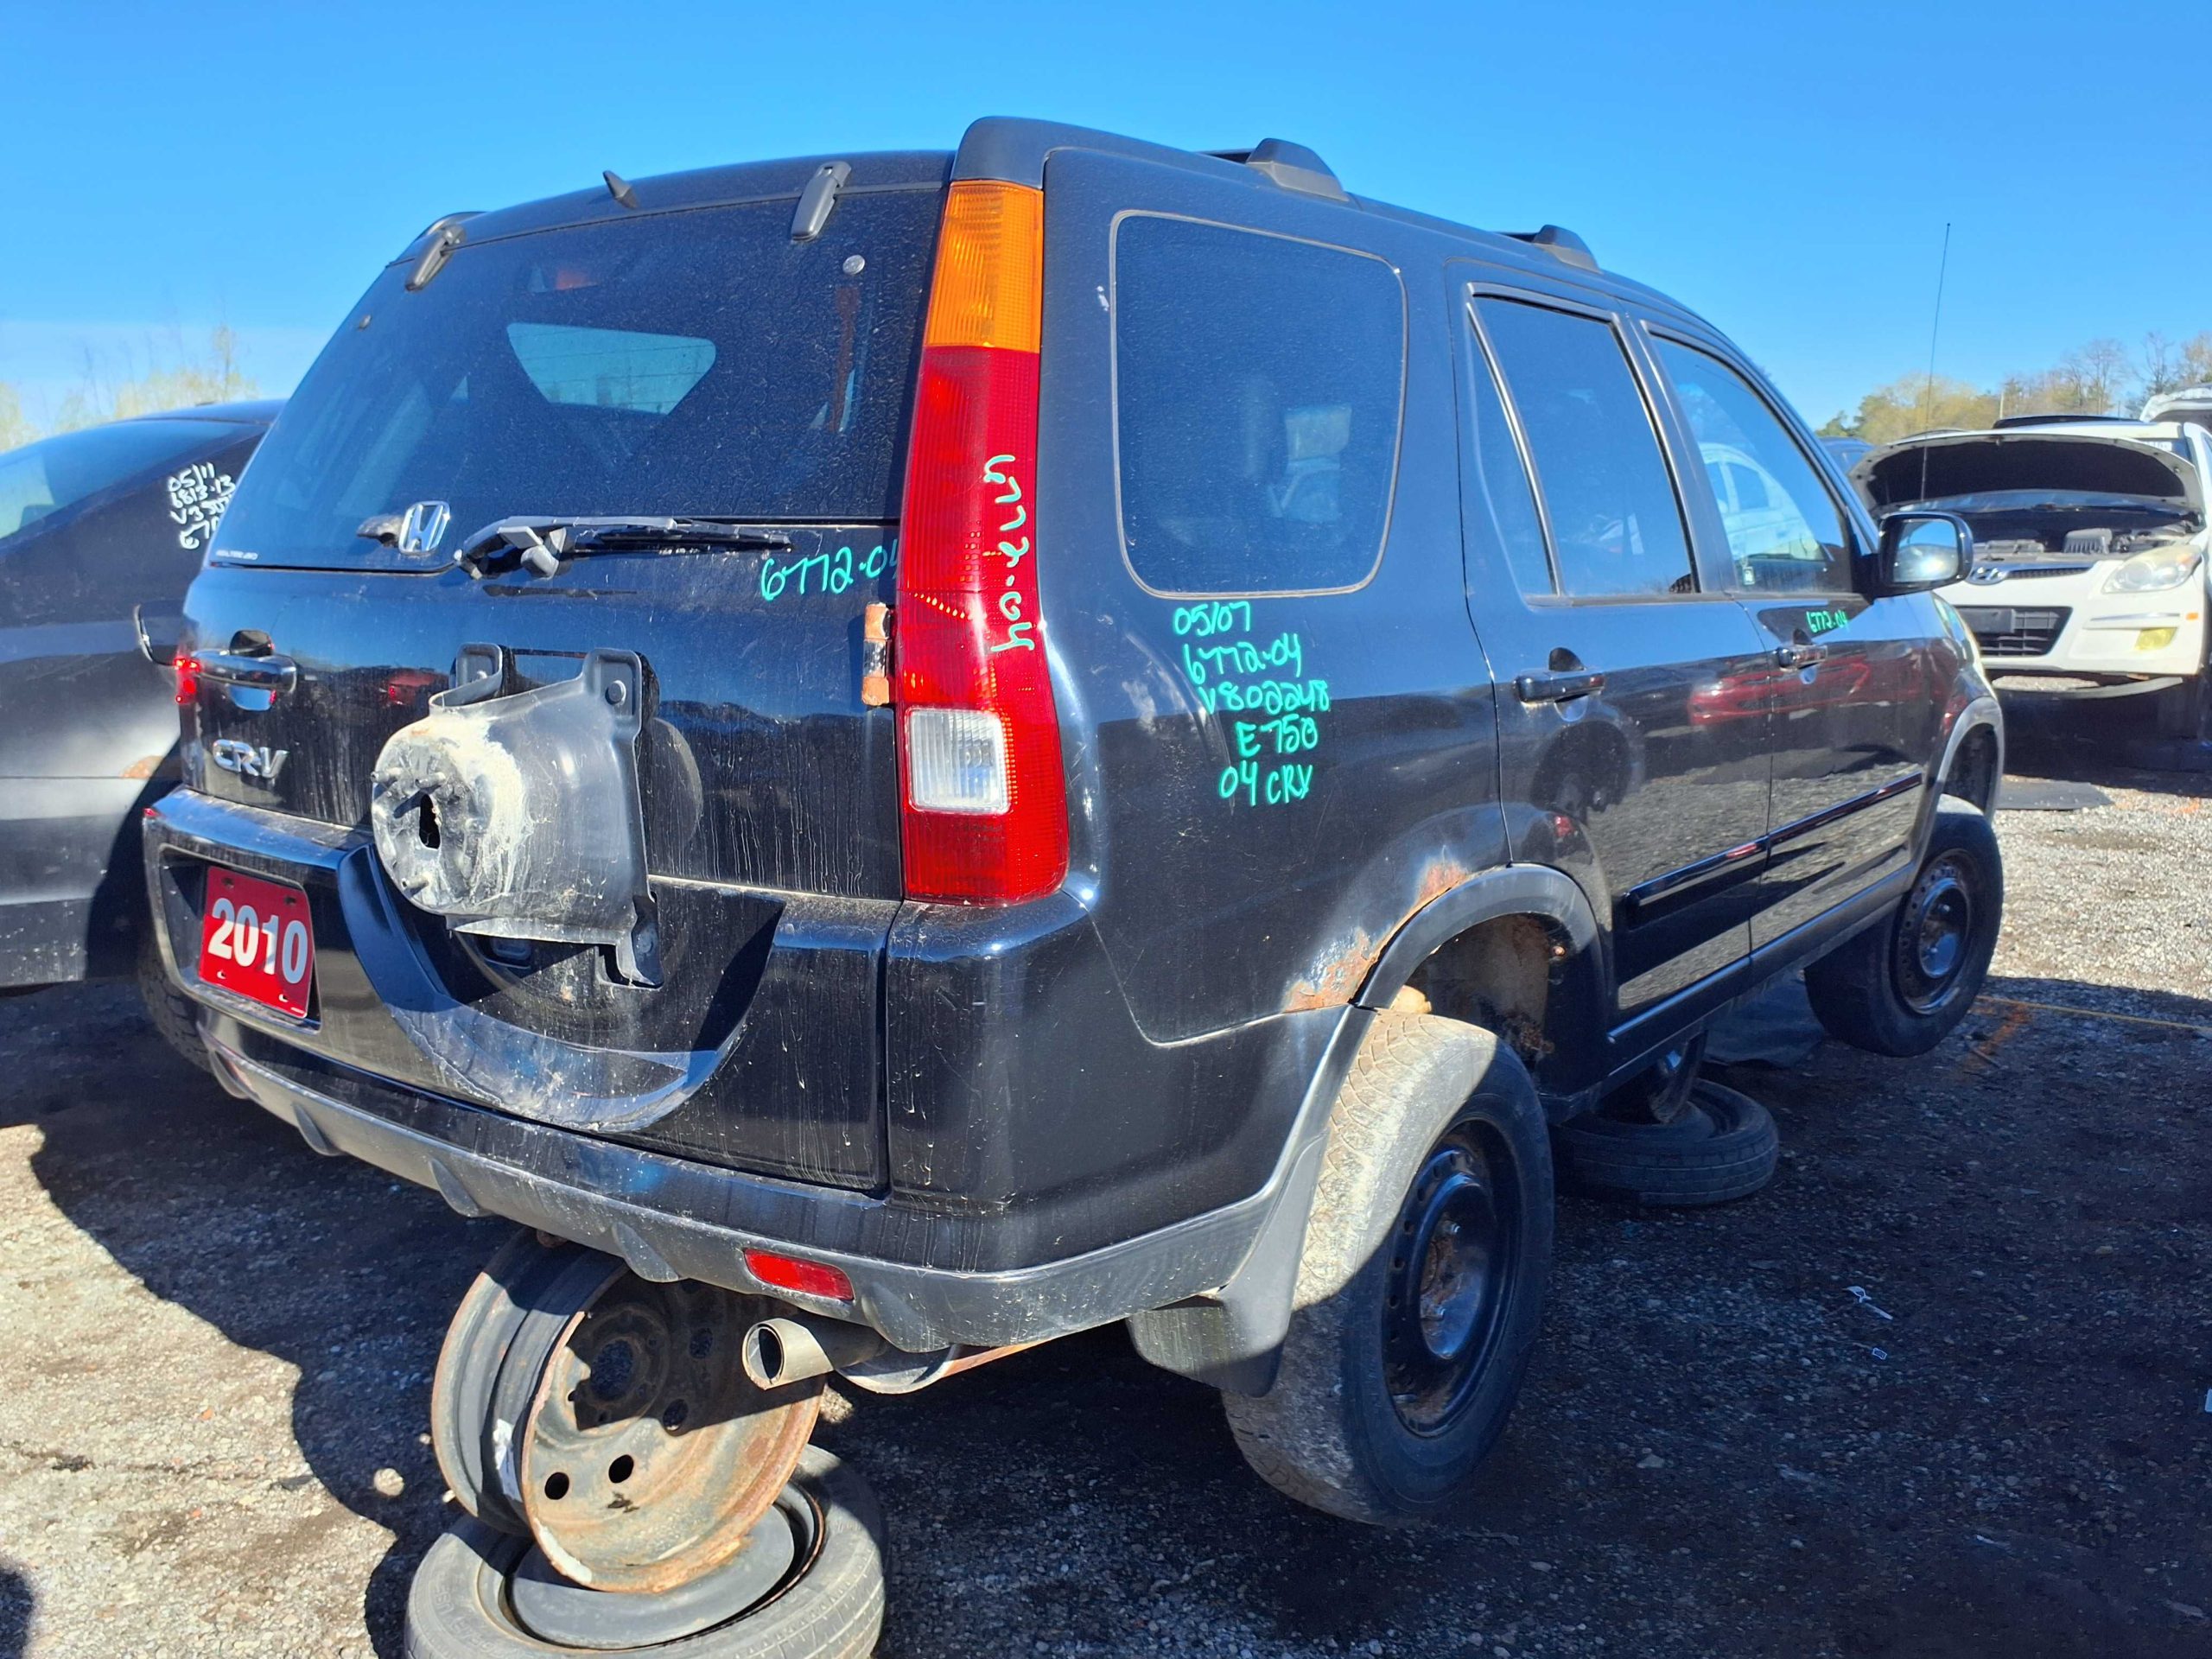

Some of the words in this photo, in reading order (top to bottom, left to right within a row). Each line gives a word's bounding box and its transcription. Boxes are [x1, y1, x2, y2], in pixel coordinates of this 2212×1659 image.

[1173, 601, 1250, 636] 05/07
[1219, 760, 1258, 806] 04
[207, 897, 308, 984] 2010
